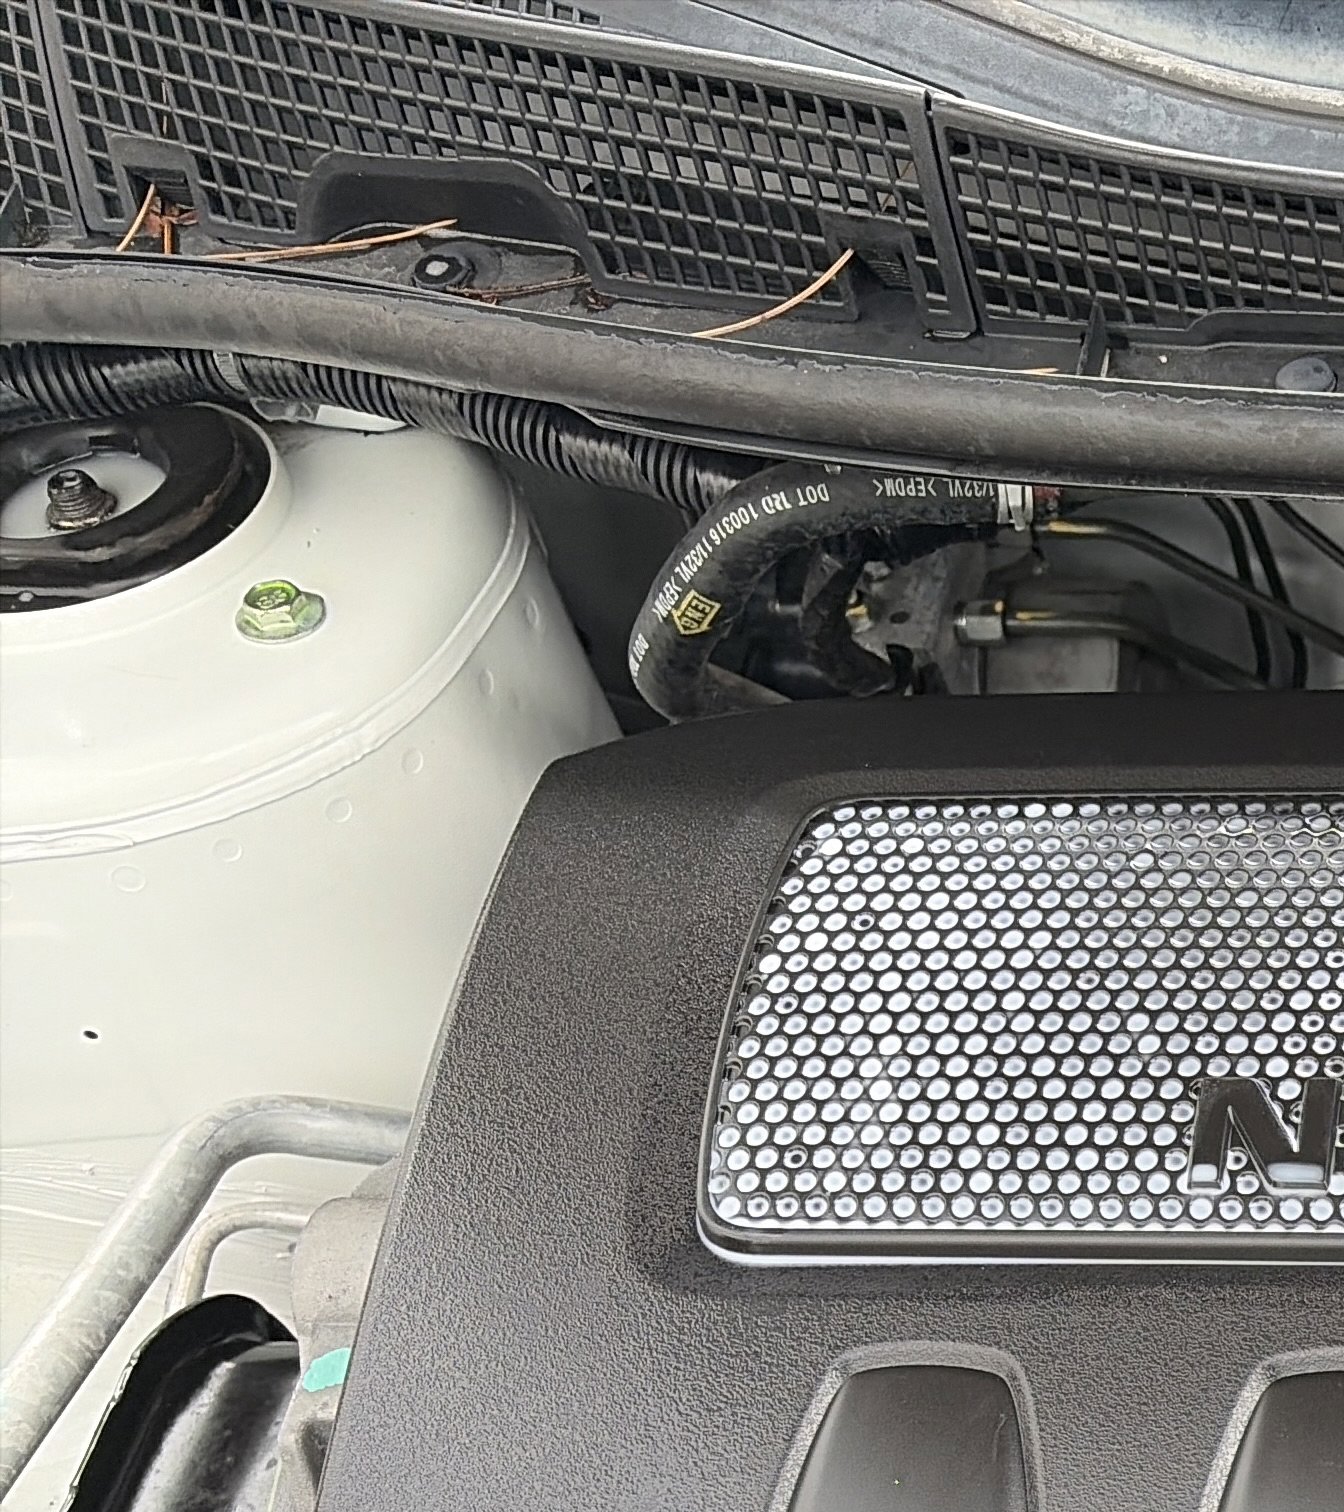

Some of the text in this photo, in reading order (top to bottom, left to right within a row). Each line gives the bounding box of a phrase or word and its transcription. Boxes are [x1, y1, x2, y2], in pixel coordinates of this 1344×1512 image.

[796, 483, 830, 507] DOT
[708, 503, 759, 546] 100316
[674, 536, 713, 584] 11/32VL
